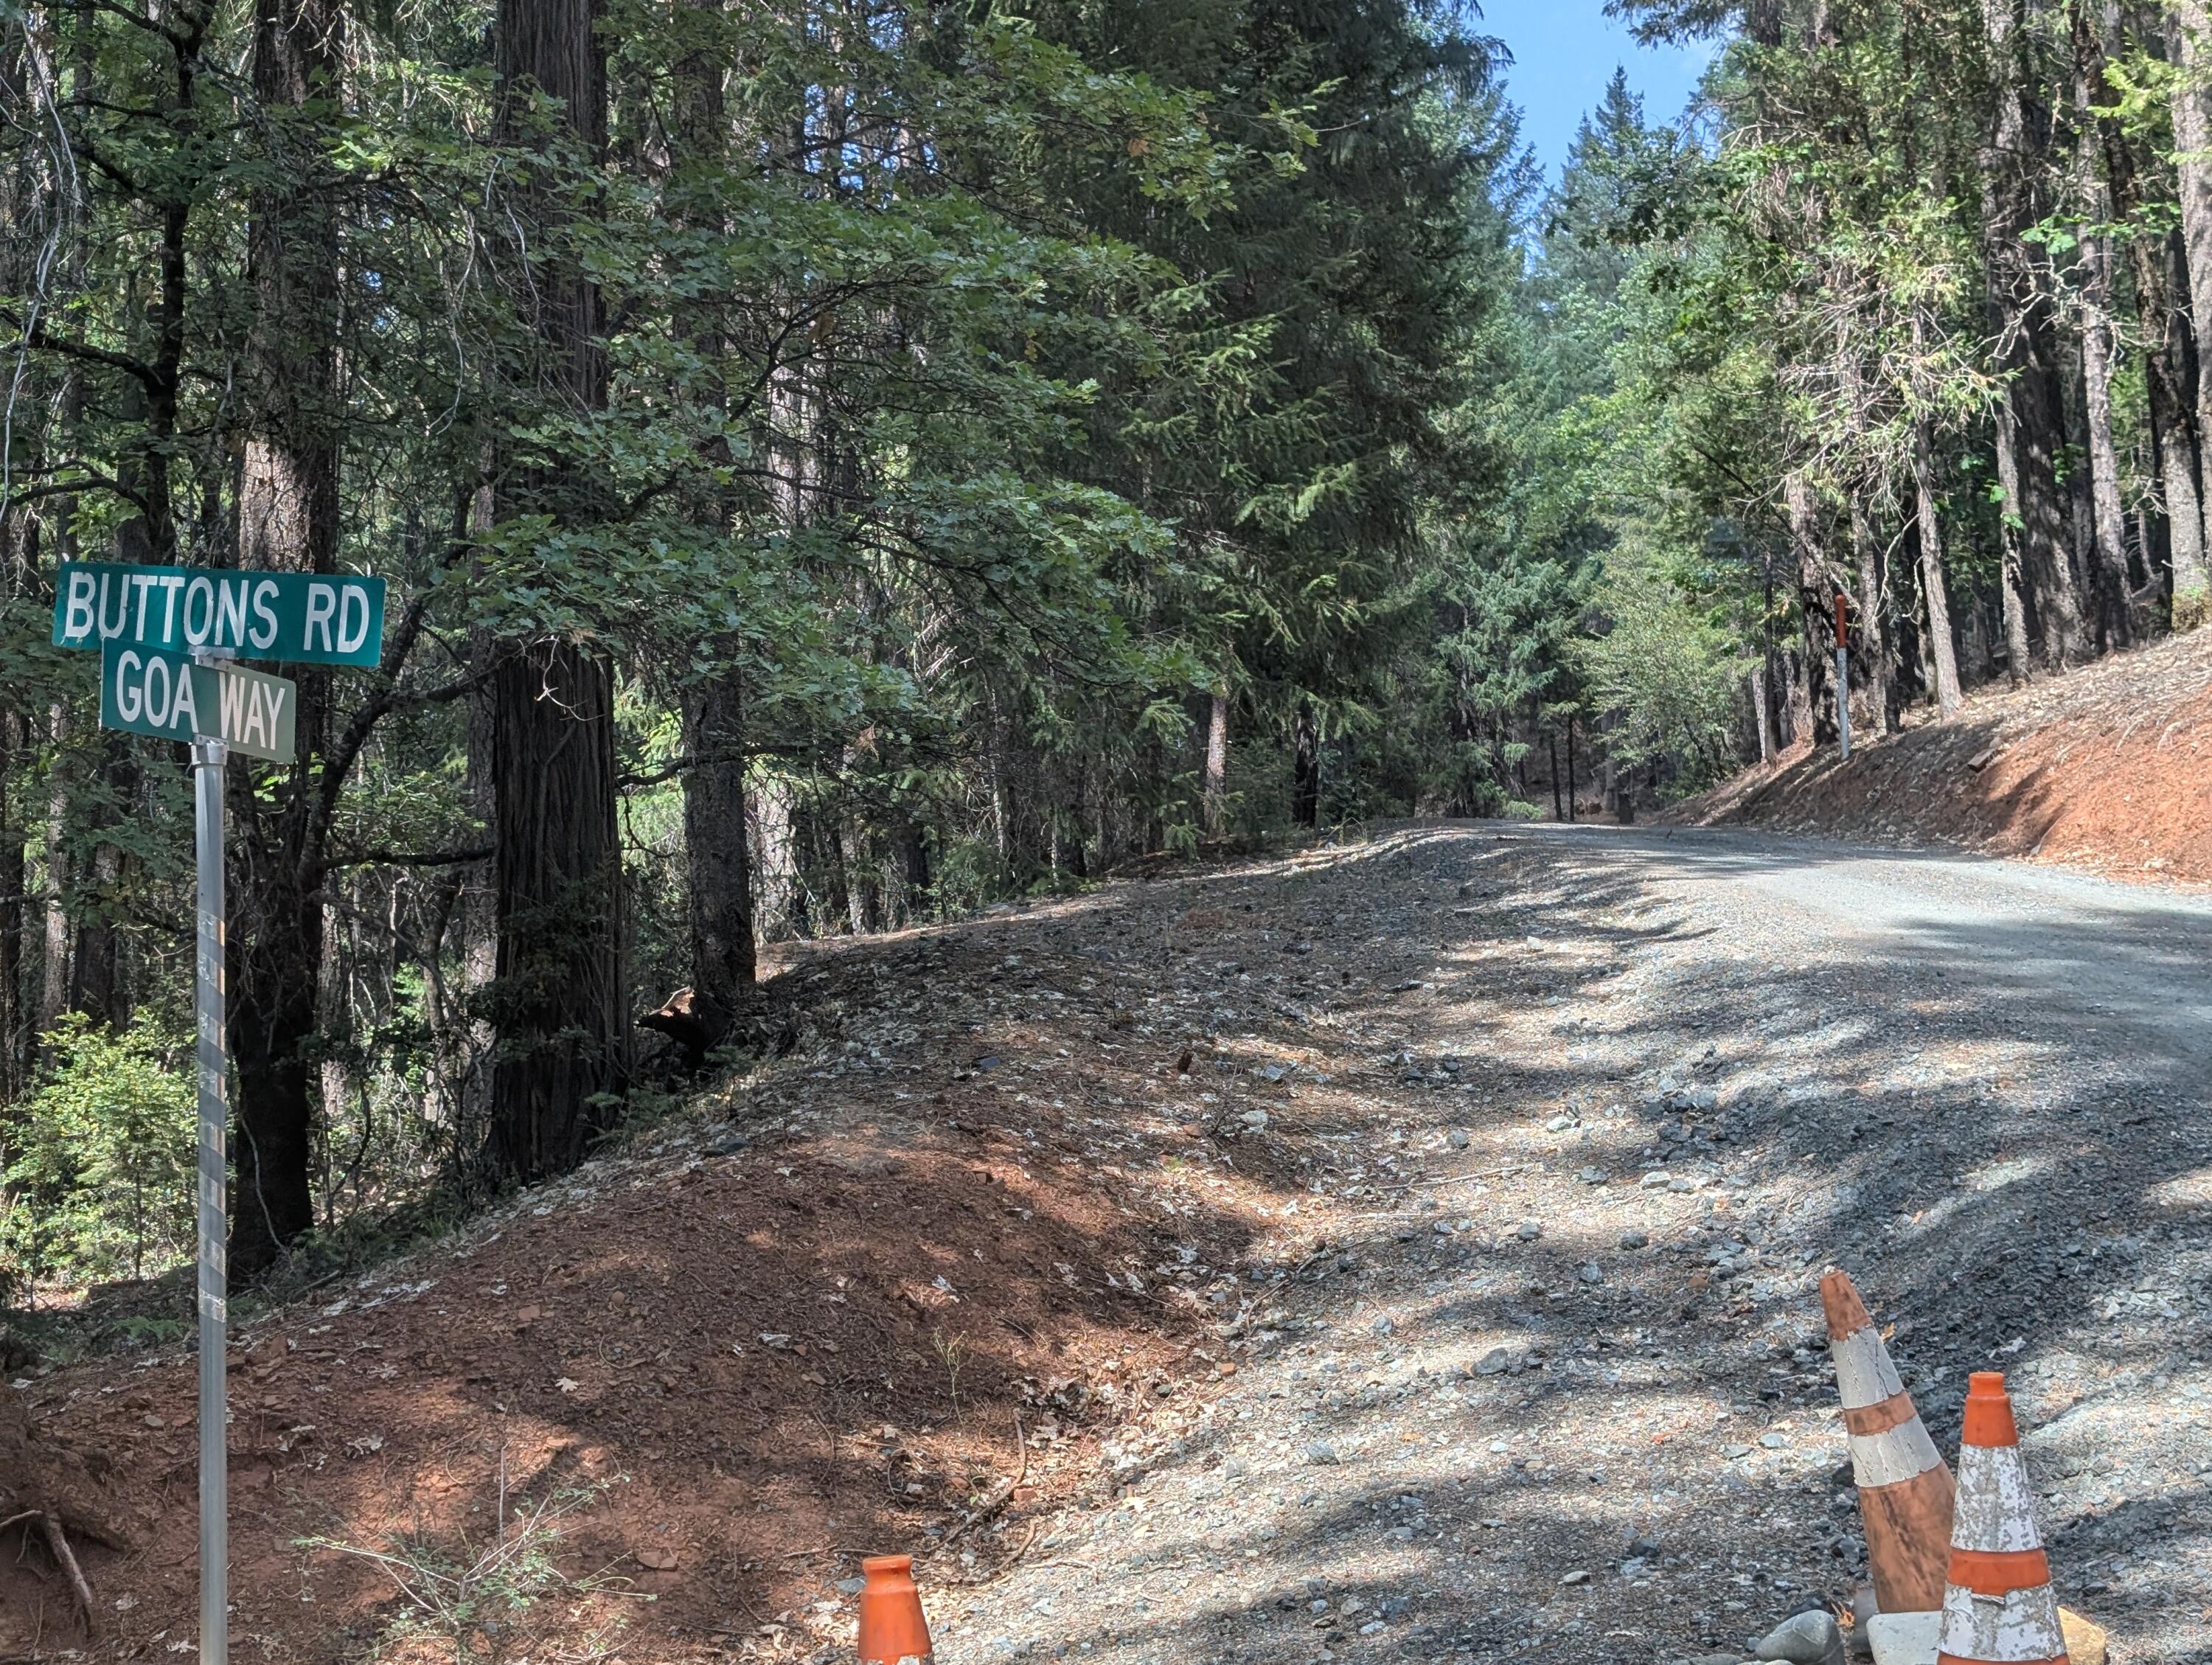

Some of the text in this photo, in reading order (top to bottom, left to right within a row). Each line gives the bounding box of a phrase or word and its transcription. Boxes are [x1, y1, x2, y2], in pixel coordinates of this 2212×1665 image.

[65, 571, 369, 653] BUTTONS RD
[116, 650, 285, 750] GOA WAY
